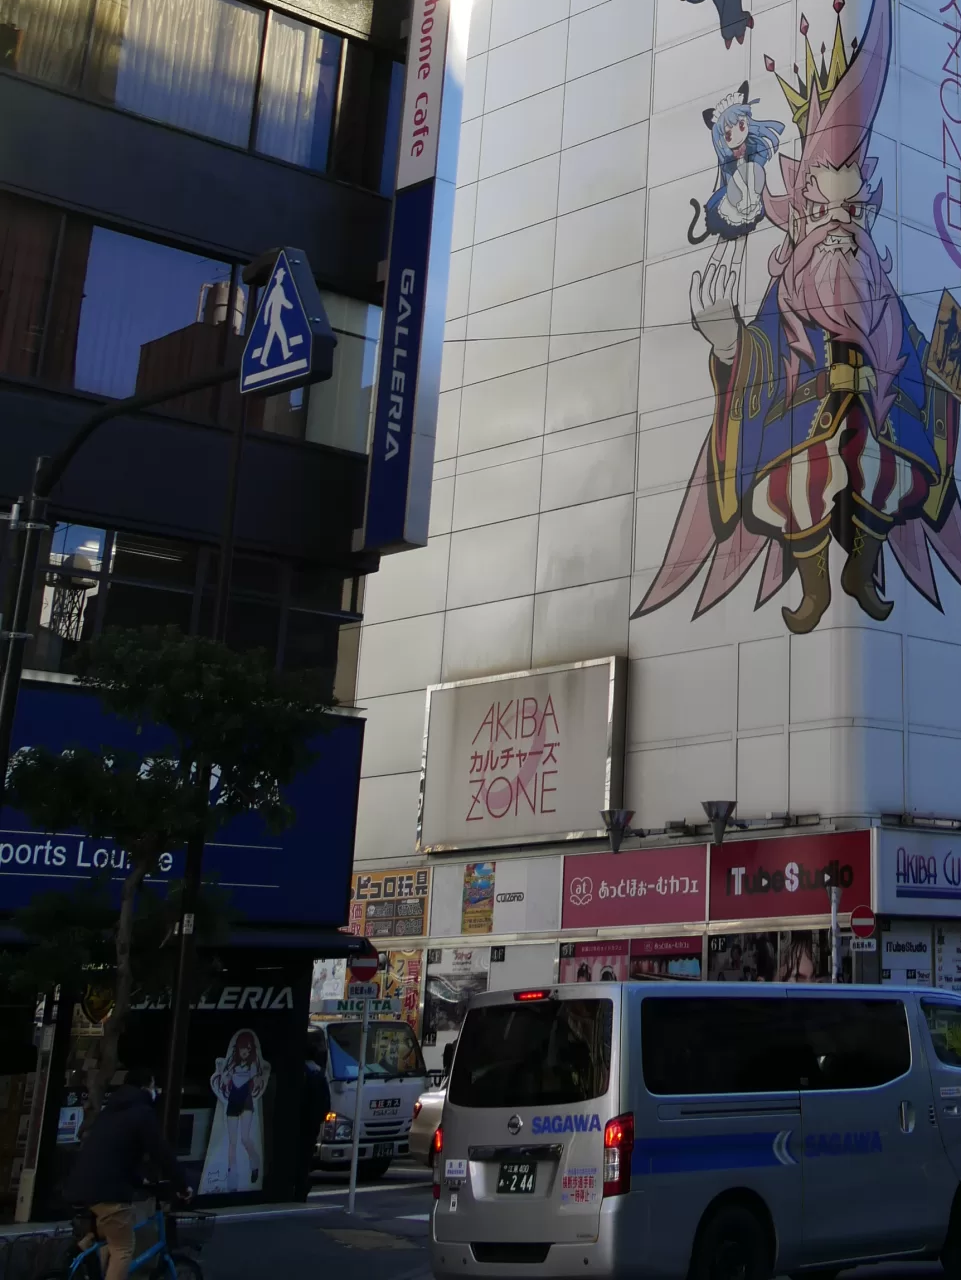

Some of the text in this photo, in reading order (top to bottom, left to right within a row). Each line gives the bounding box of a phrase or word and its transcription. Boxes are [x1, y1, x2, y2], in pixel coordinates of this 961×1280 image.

[410, 91, 430, 158] cafe
[384, 267, 416, 462] GALLERIA
[472, 693, 559, 746] AKIBA
[469, 741, 561, 775] カルチャーズ
[465, 770, 559, 822] ZONE
[76, 840, 173, 872] Loue
[896, 846, 937, 886] AKIBA
[711, 937, 726, 951] 6F
[532, 1113, 602, 1135] SAGAWA
[805, 1131, 883, 1158] SAGAWA
